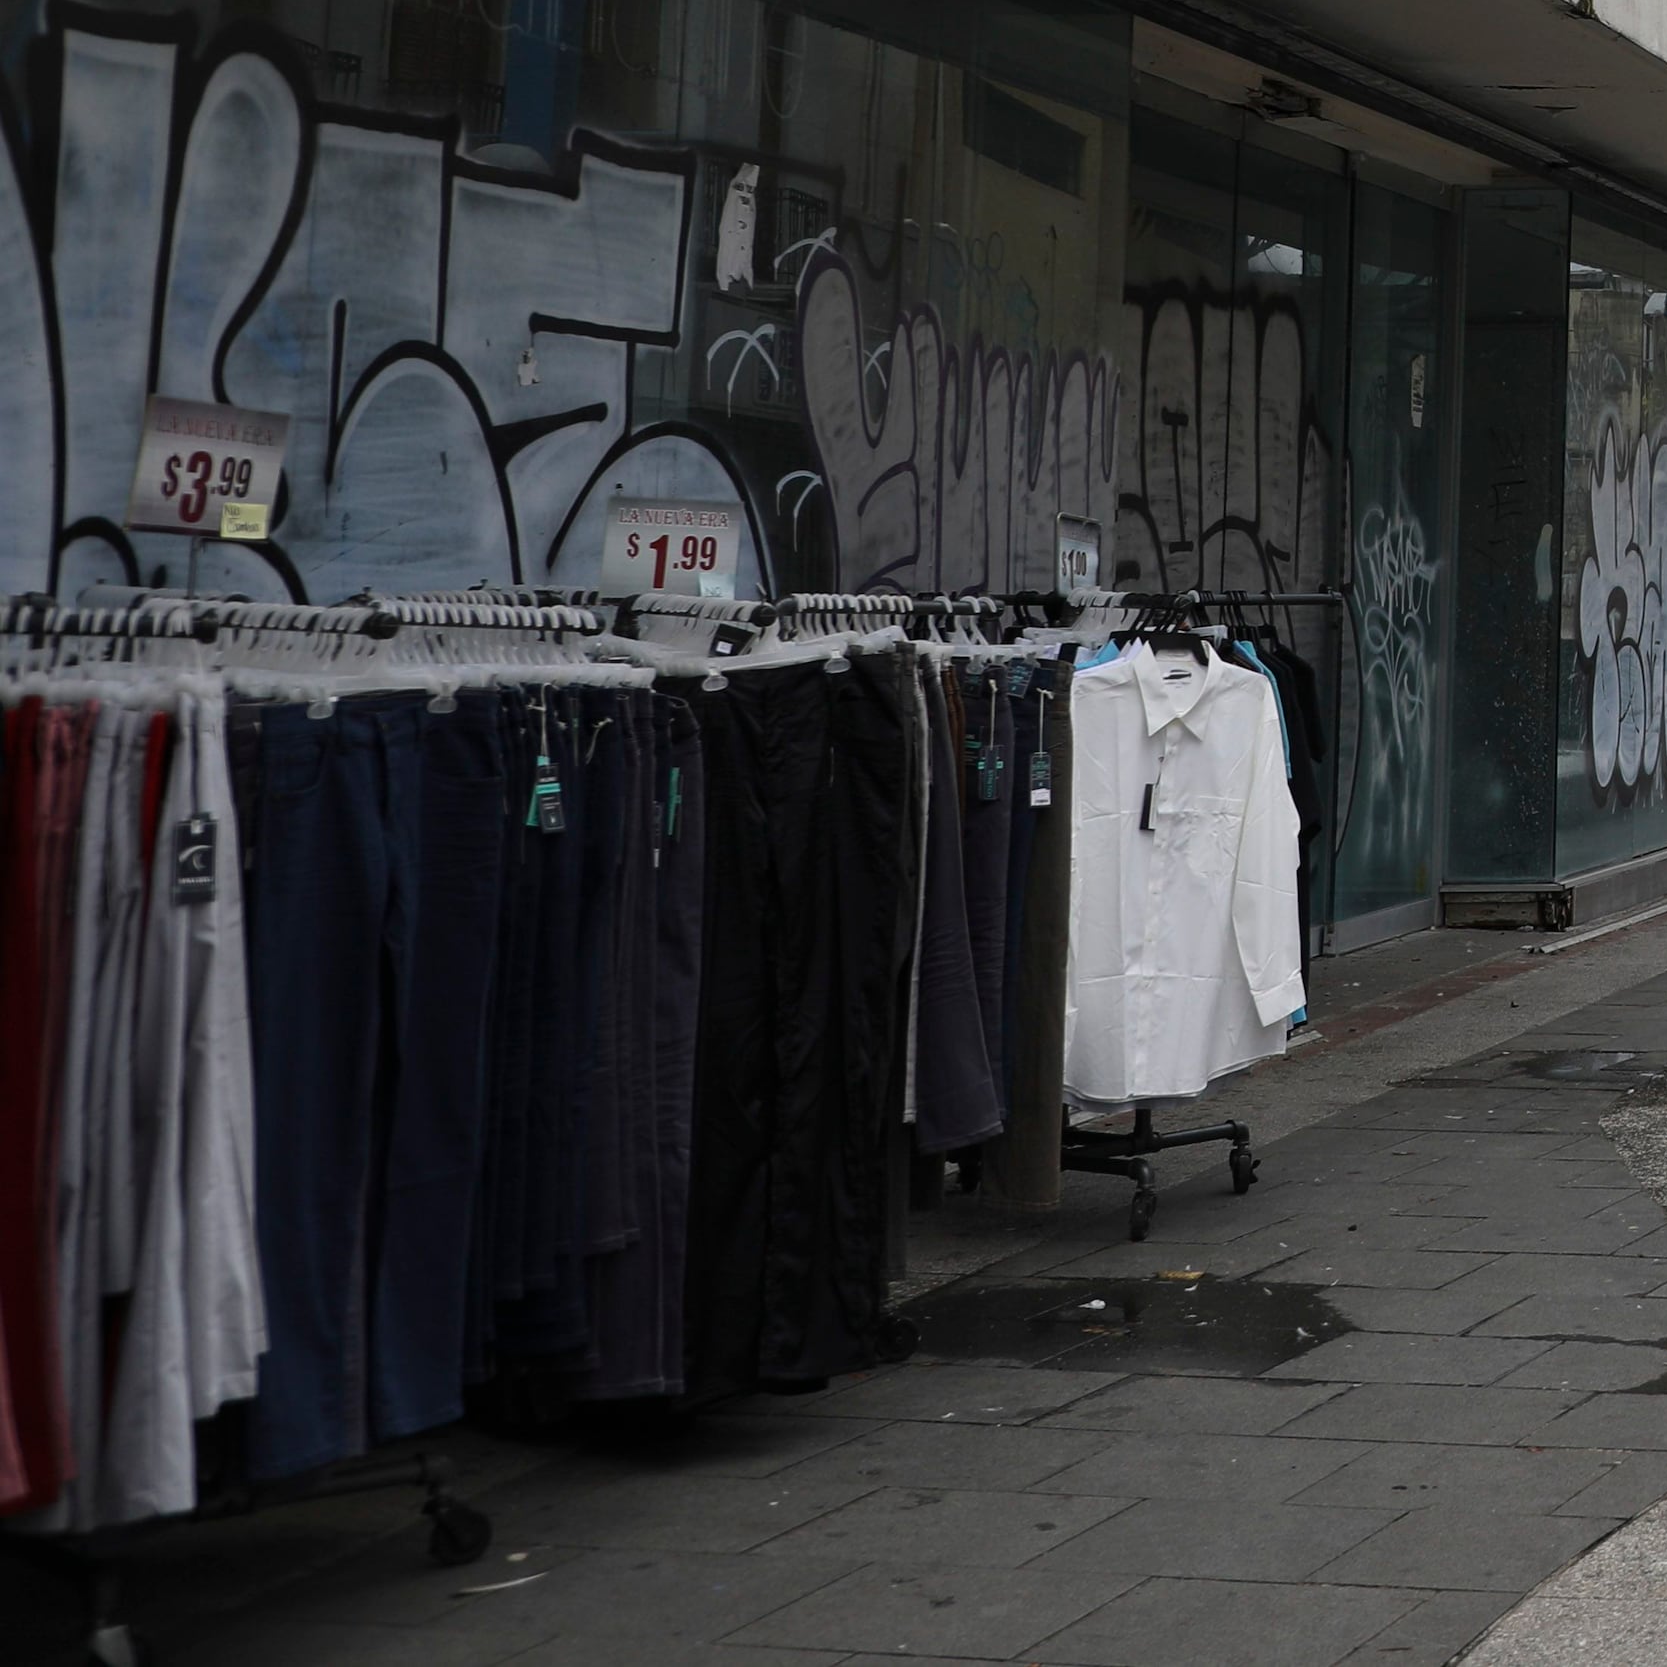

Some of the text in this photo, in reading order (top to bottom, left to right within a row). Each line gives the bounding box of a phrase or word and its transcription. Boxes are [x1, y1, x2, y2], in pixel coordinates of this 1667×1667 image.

[183, 418, 238, 442] NUEVA
[242, 425, 276, 447] ERA
[161, 451, 252, 523] $3.99
[619, 508, 729, 528] LA NUEVA ERA
[627, 532, 717, 589] $1.99
